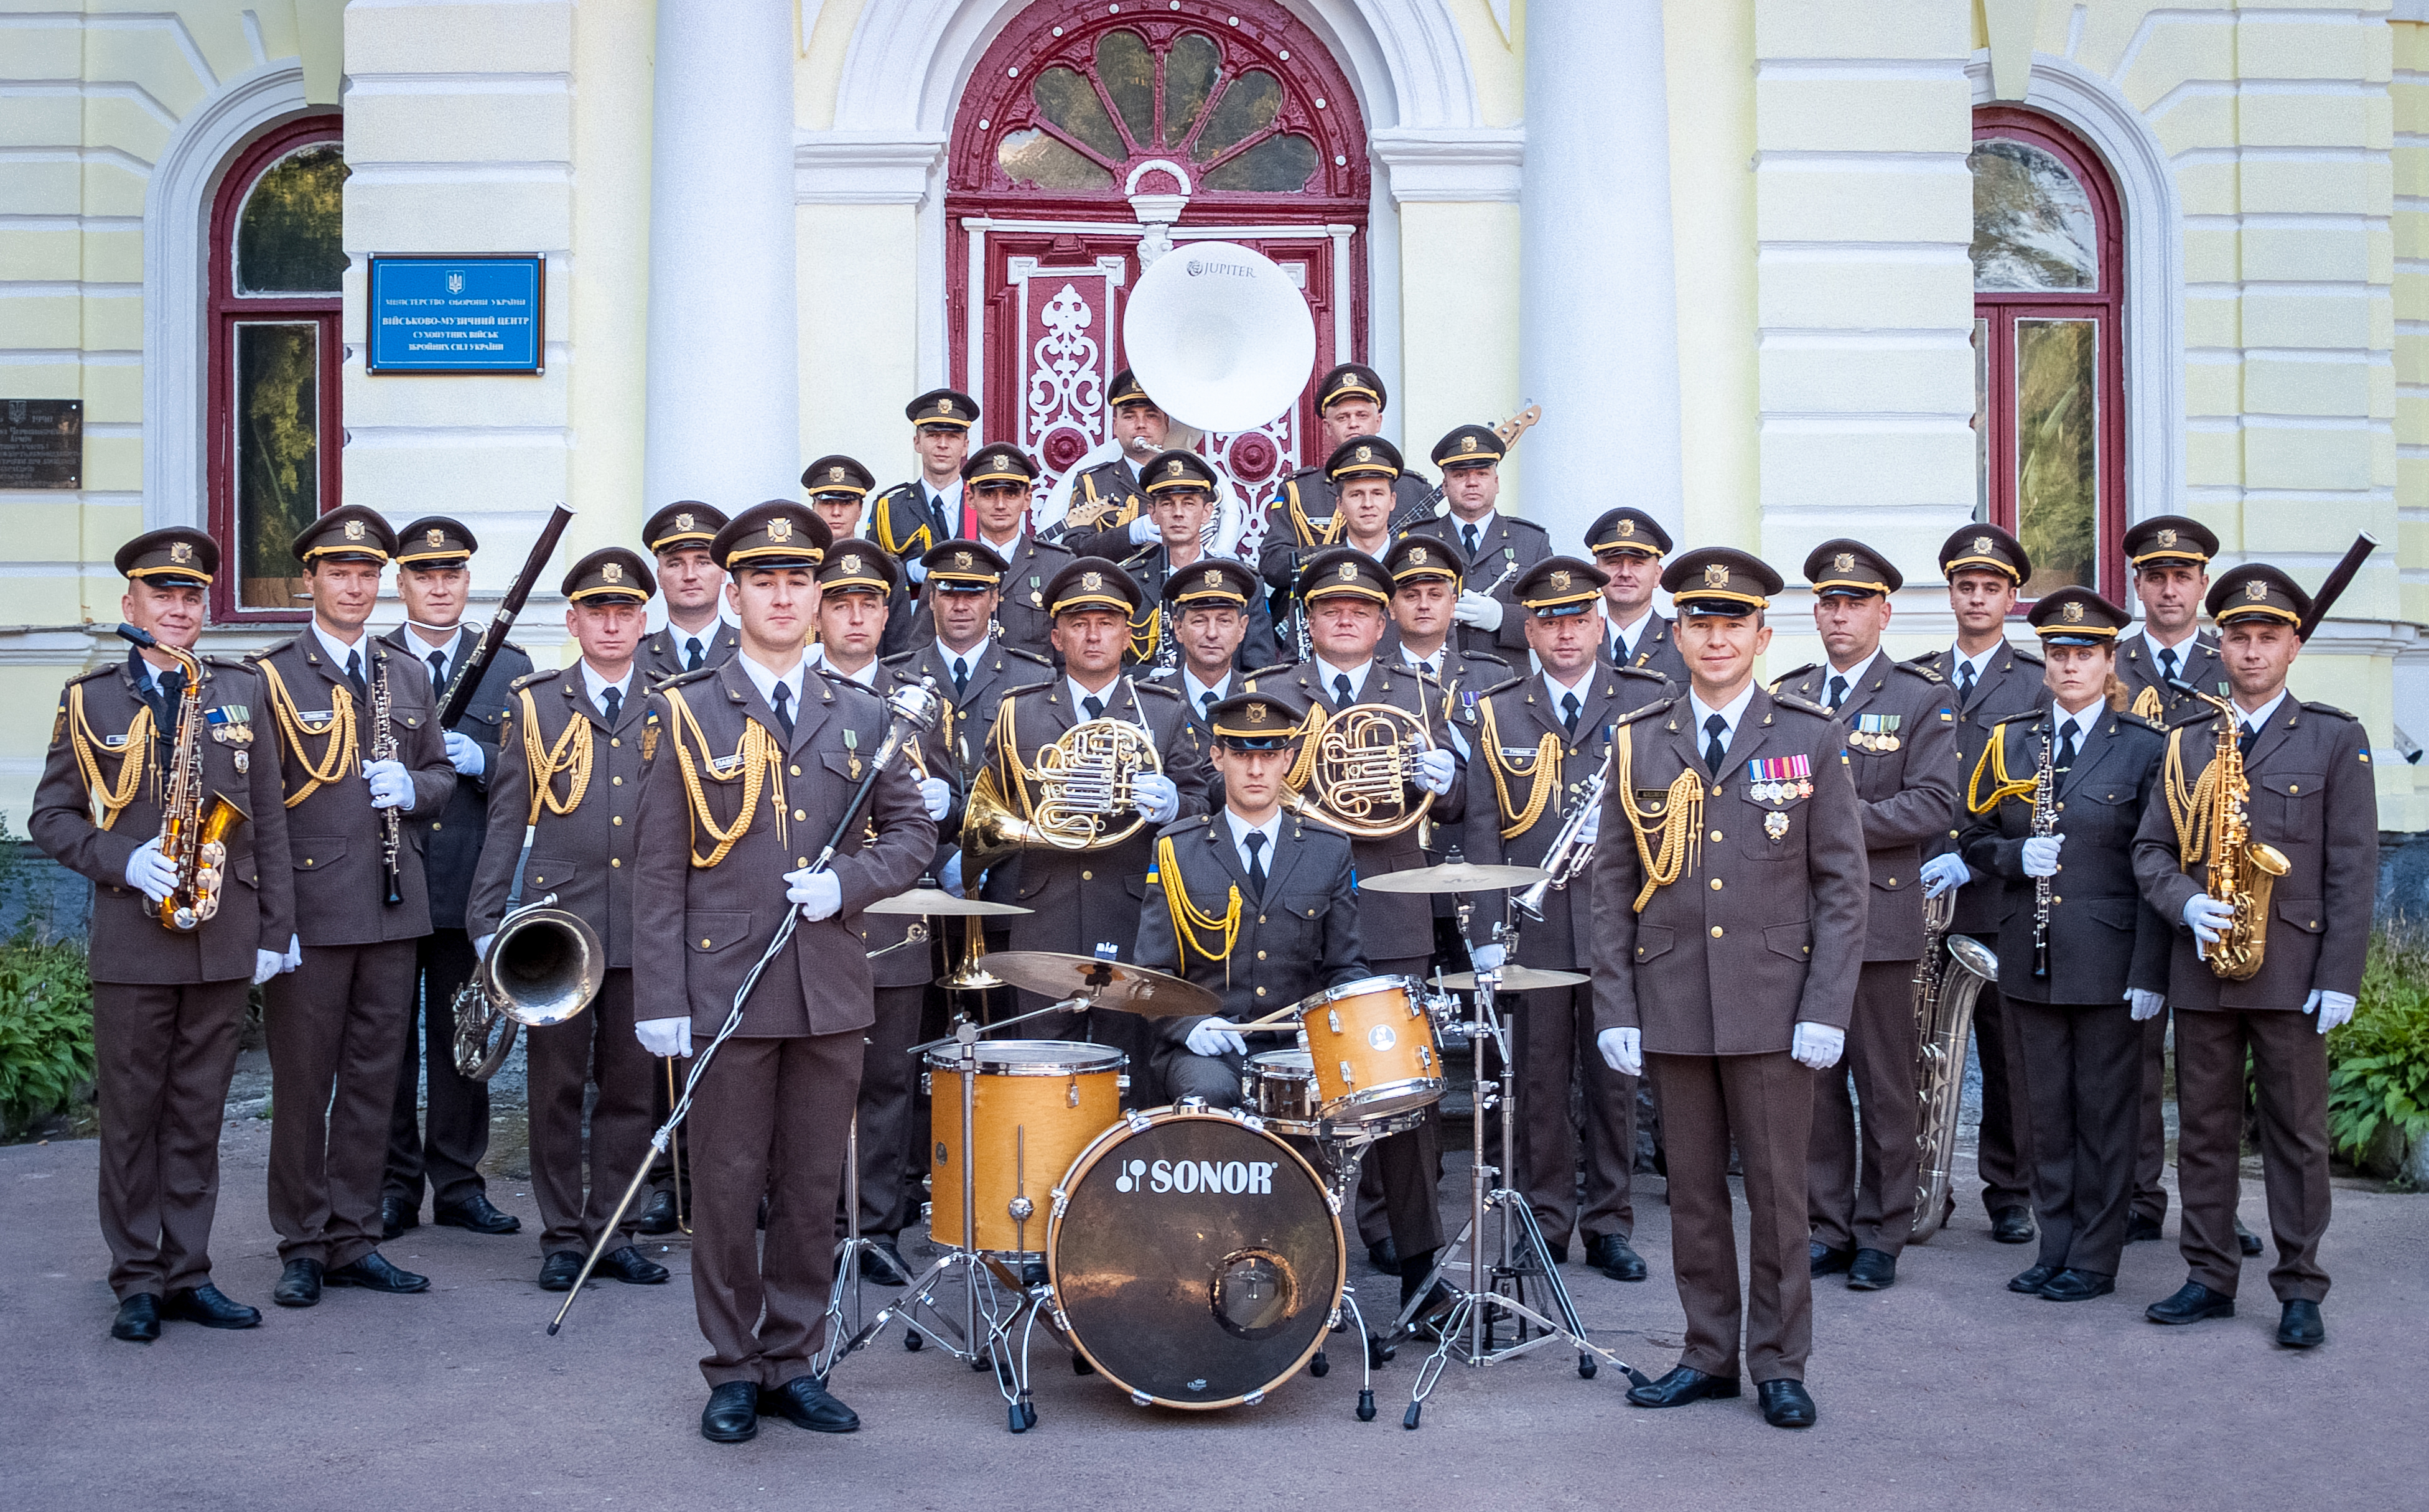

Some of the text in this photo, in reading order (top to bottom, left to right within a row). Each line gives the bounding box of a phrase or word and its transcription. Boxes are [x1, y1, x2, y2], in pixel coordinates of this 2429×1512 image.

[1204, 262, 1256, 278] JUPITER
[383, 315, 529, 325] ВІЙСЬКОВО-МУЗИЧНИЙ ЦЕНТР
[469, 330, 499, 338] ВІЙСЬК
[409, 342, 449, 350] ЗБРОЙНИХ
[469, 342, 504, 350] УКРАЇНИ
[1150, 1159, 1273, 1194] SONOR
